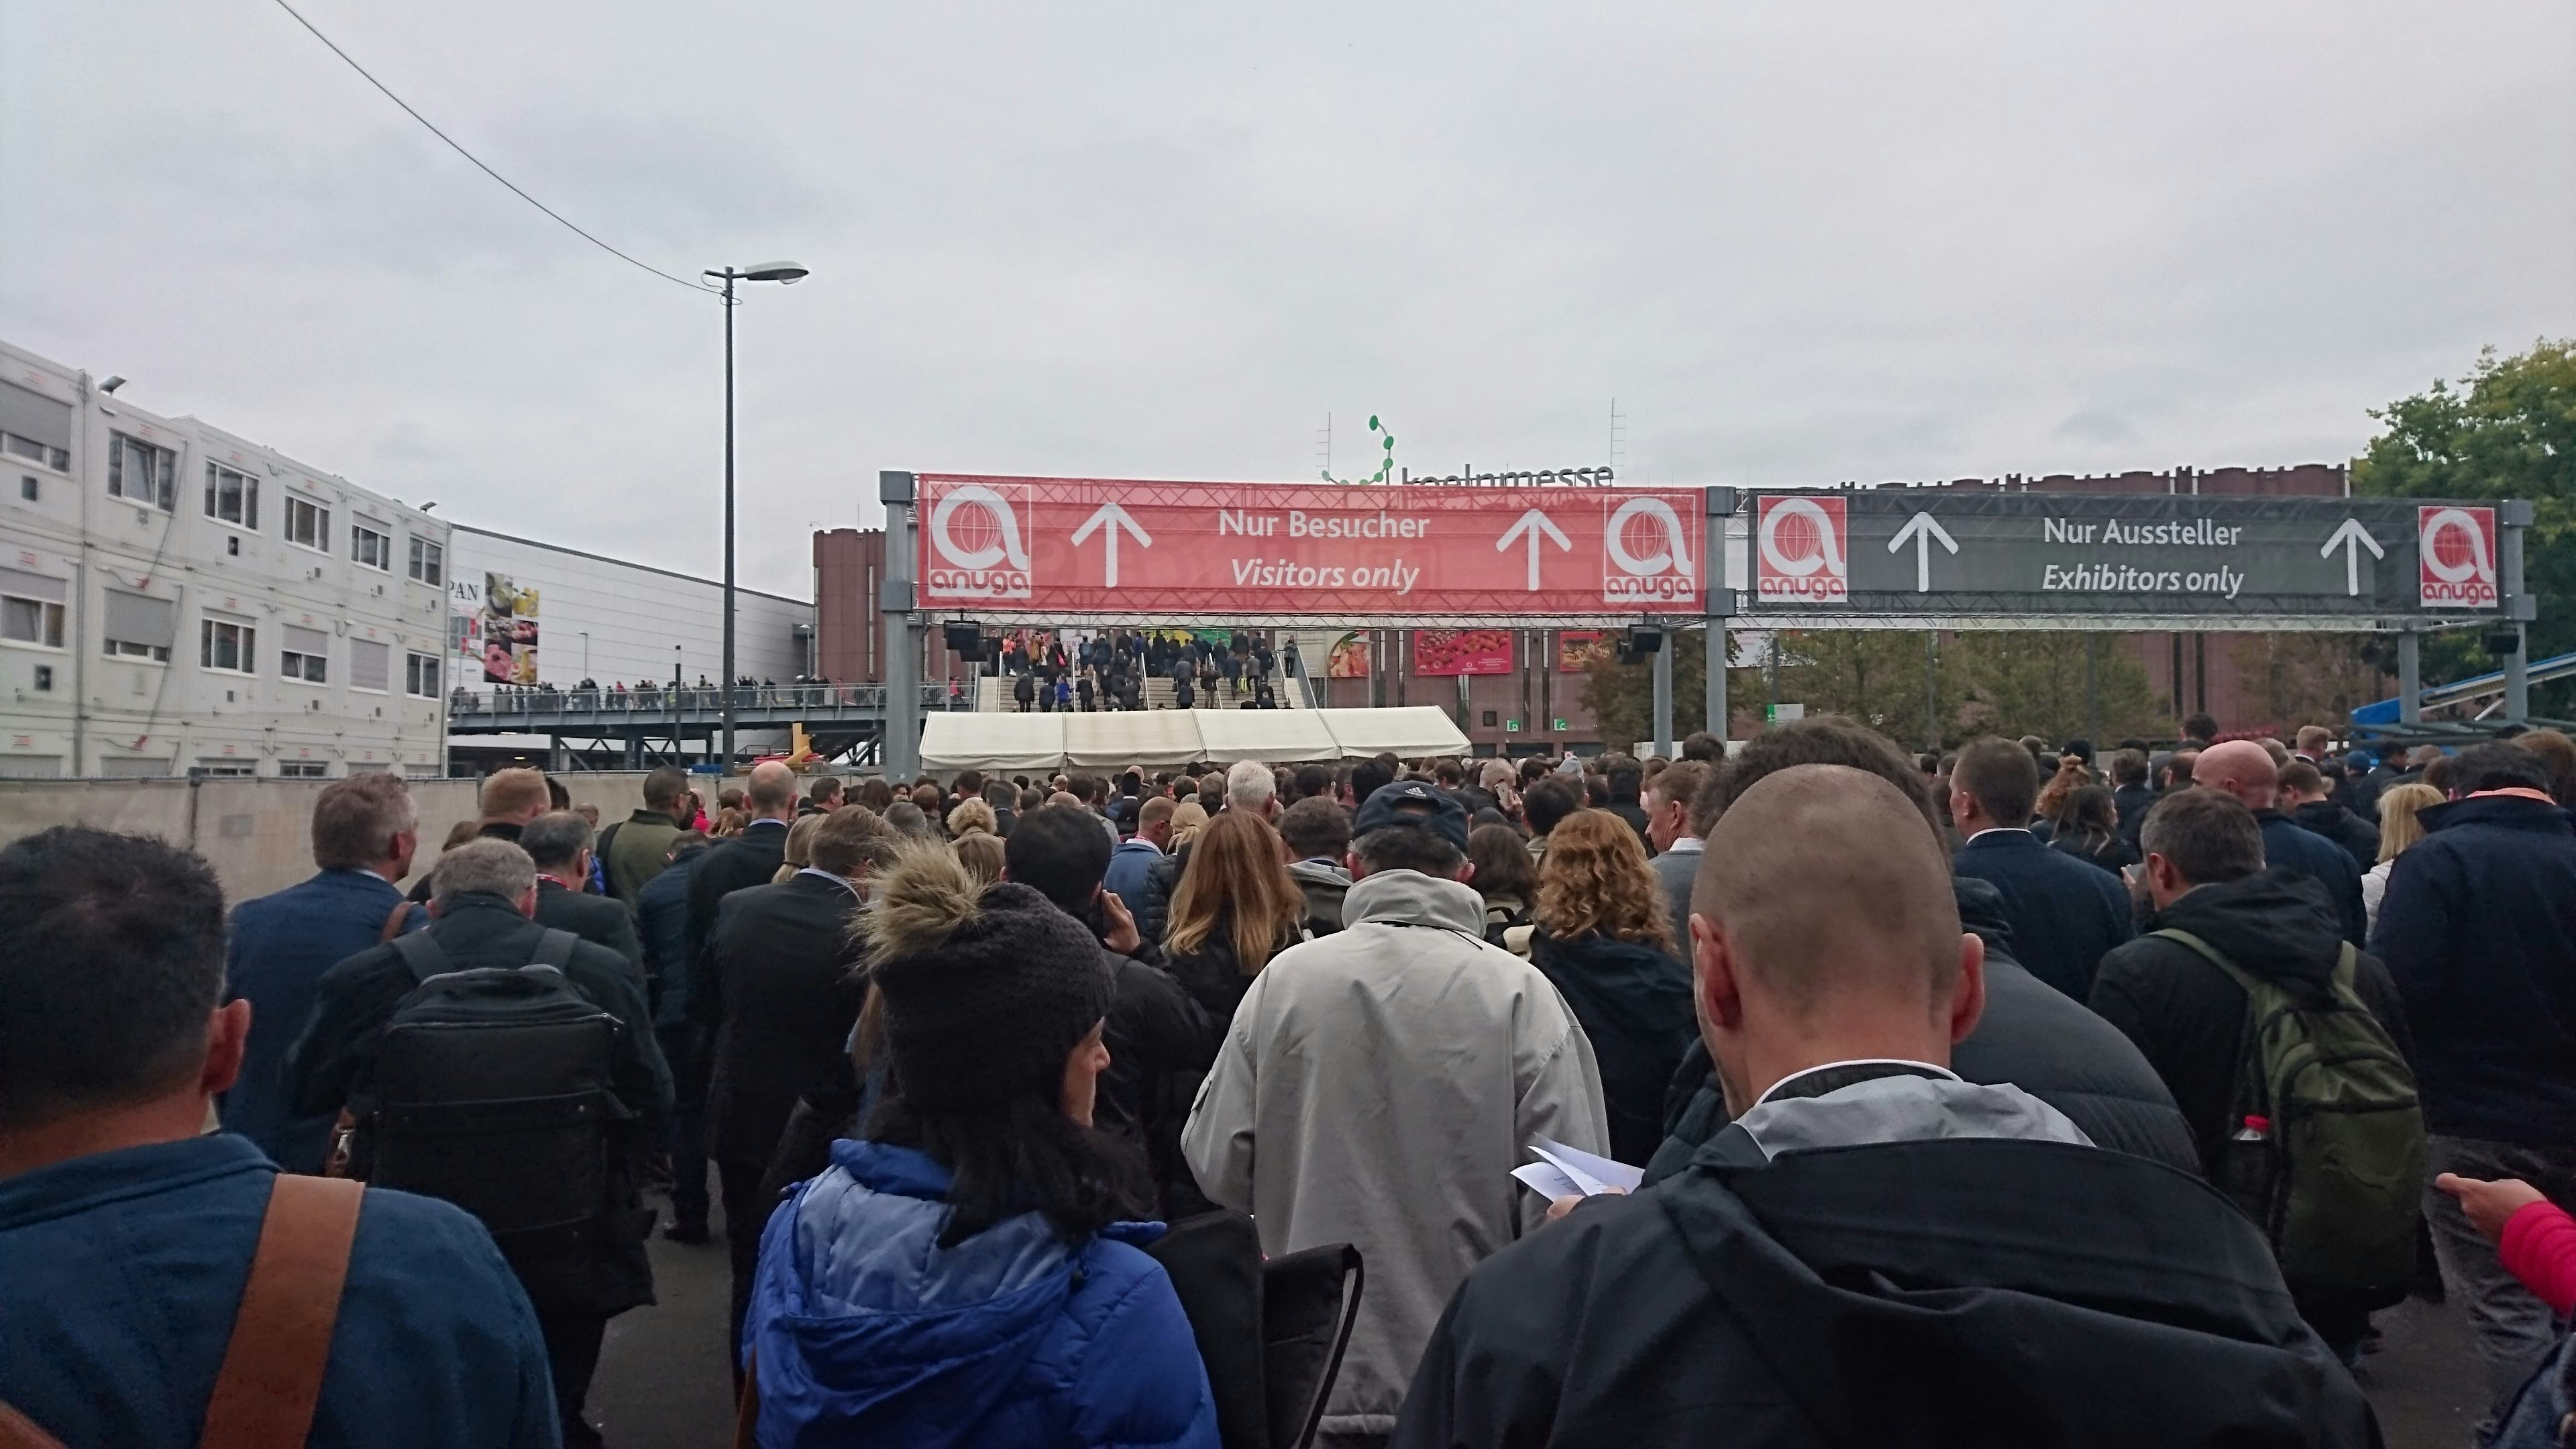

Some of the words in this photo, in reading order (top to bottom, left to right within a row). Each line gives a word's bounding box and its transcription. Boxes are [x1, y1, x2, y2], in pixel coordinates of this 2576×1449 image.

[1220, 509, 1279, 536] Nur
[1289, 511, 1430, 538] Besucher
[2044, 517, 2097, 543] Nur
[2102, 519, 2242, 545] Aussteller
[930, 570, 1030, 596] anuga
[1232, 558, 1345, 587] Visitors
[1352, 559, 1420, 594] only
[1606, 577, 1694, 600] anuga
[1760, 578, 1846, 600] anuga
[2042, 563, 2181, 591] Exhibitors
[2186, 564, 2245, 599] only
[2422, 584, 2496, 605] anuga
